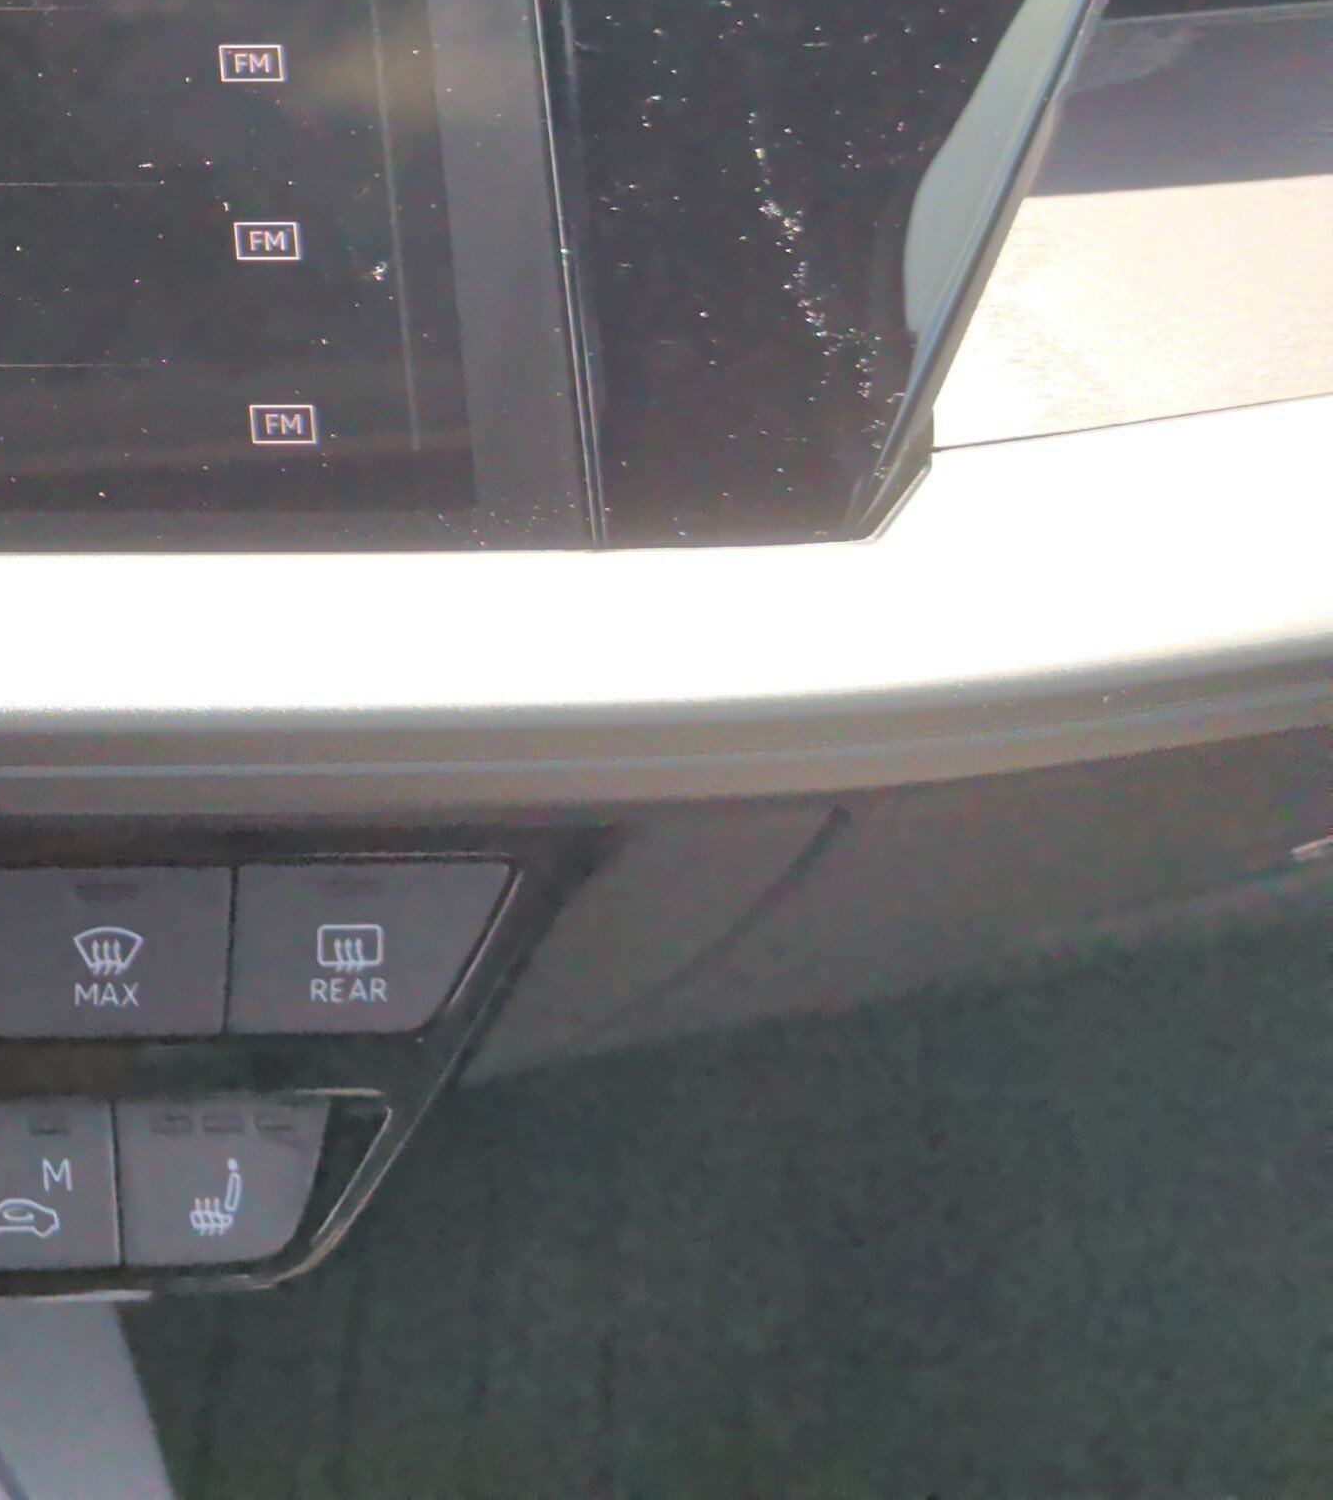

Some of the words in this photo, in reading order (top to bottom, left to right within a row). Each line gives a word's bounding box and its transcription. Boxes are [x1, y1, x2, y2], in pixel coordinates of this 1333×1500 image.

[234, 53, 270, 74] FM
[249, 230, 286, 252] FM
[265, 413, 302, 435] FM
[73, 982, 139, 1007] MAX
[310, 978, 388, 1003] REAR
[42, 1159, 73, 1192] M
